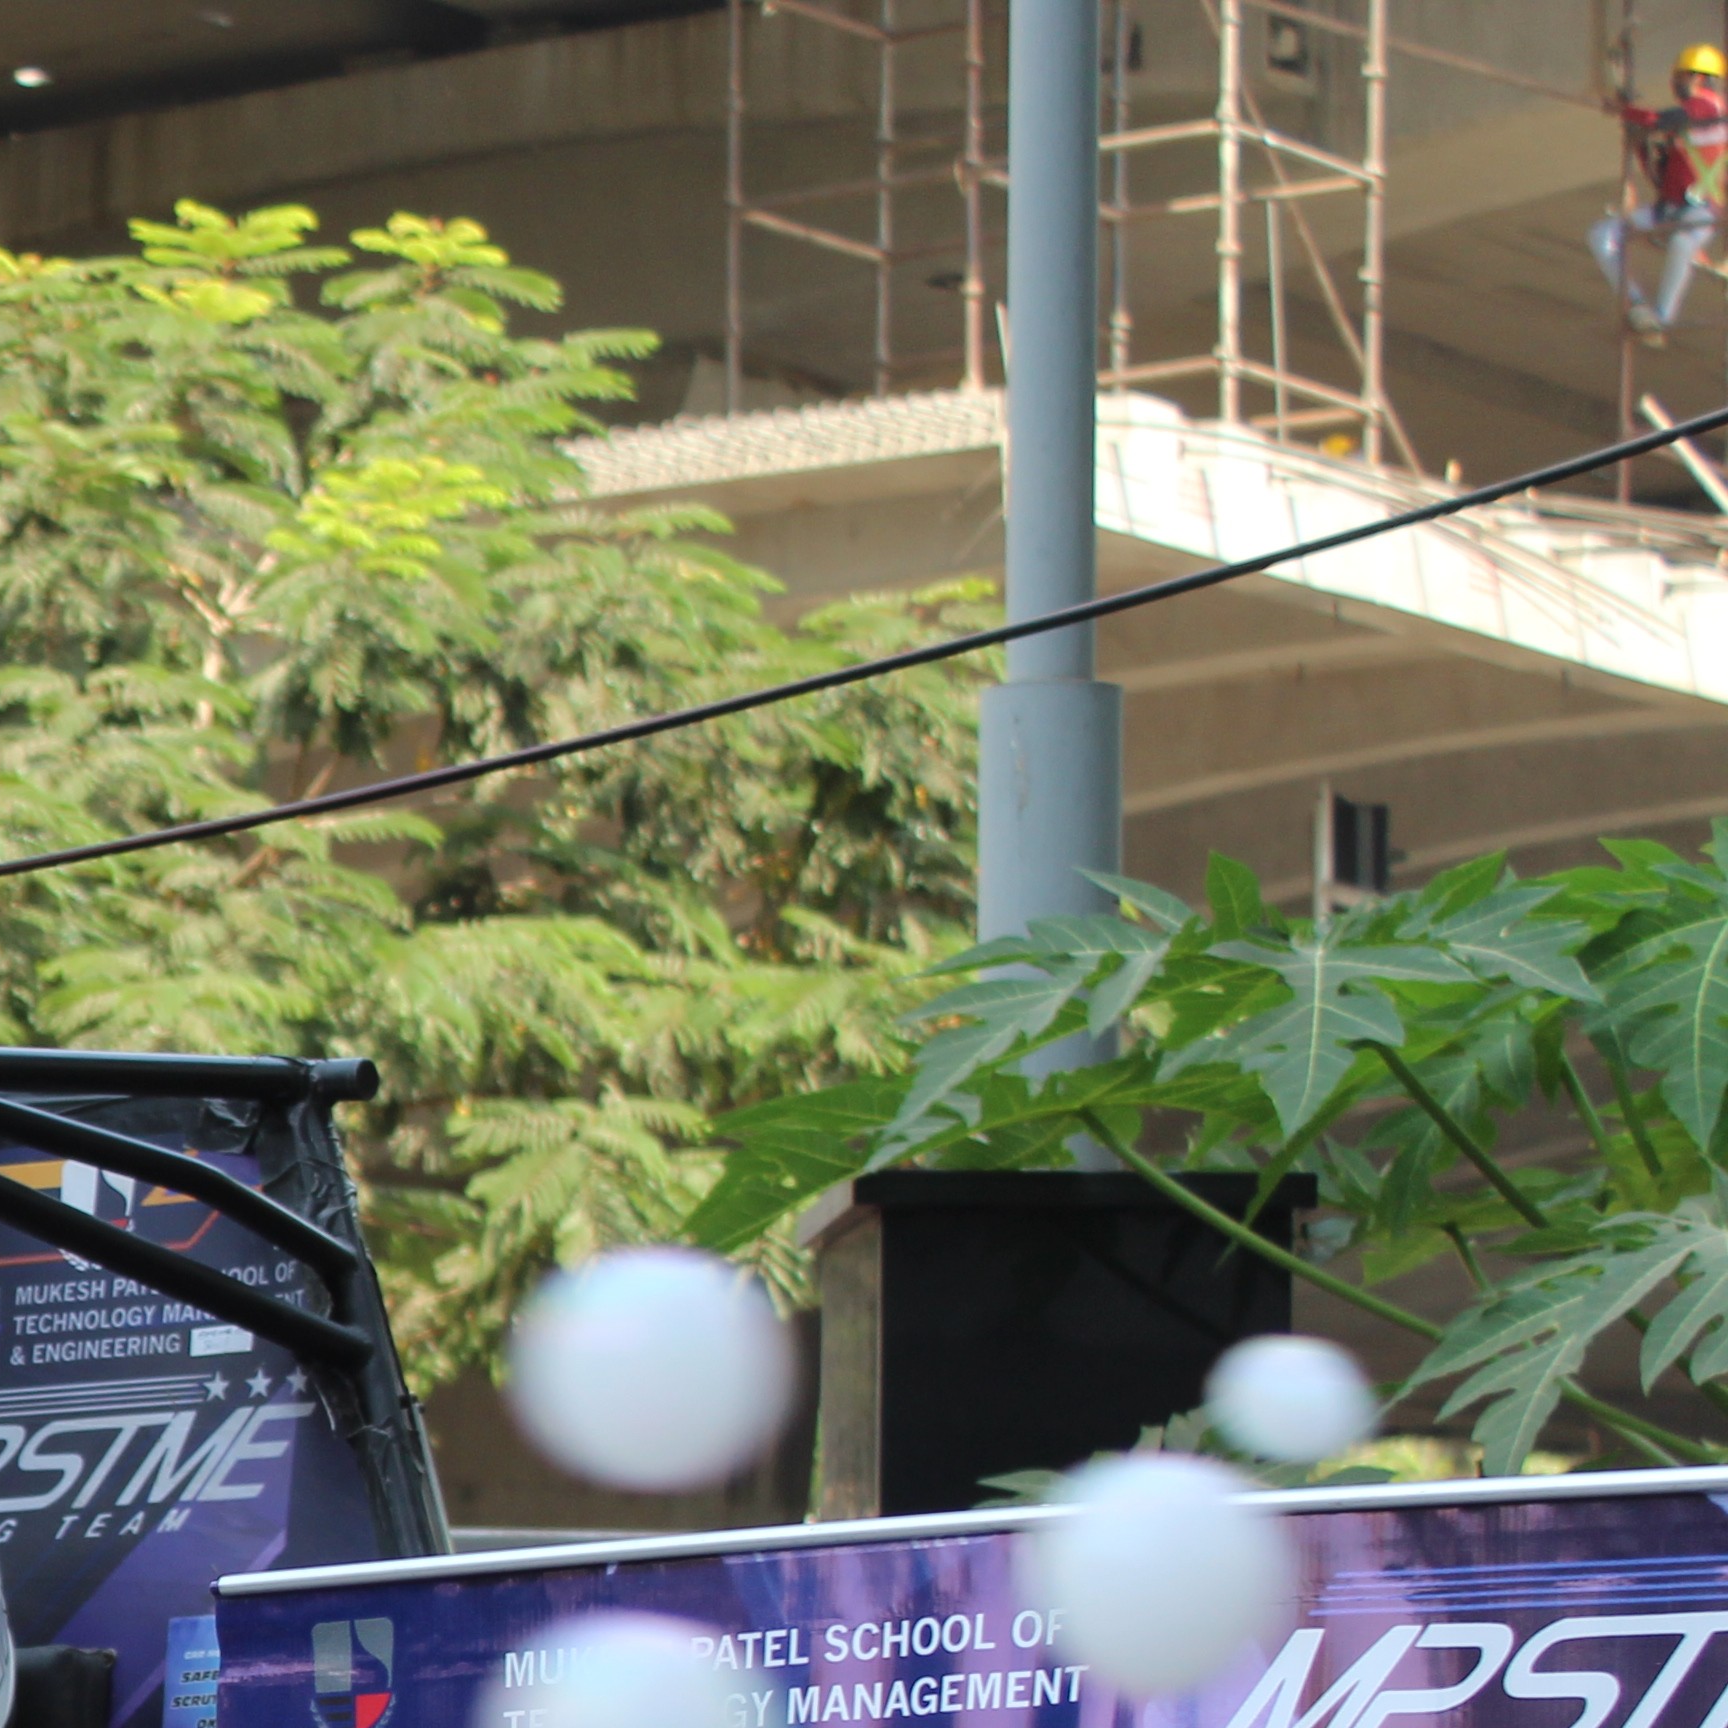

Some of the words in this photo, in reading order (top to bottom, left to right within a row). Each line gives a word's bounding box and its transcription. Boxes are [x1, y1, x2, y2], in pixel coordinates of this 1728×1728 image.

[15, 1279, 106, 1306] MUKESH
[274, 1261, 297, 1283] OF
[13, 1305, 156, 1335] TECHNOLOGY
[10, 1345, 27, 1366] &
[32, 1333, 182, 1365] ENGINEERING
[55, 1508, 190, 1539] TEAM
[690, 1628, 810, 1672] PATEL
[824, 1612, 996, 1663] SCHOOL
[1011, 1608, 1068, 1649] OF
[787, 1665, 1091, 1726] MANAGEMENT
